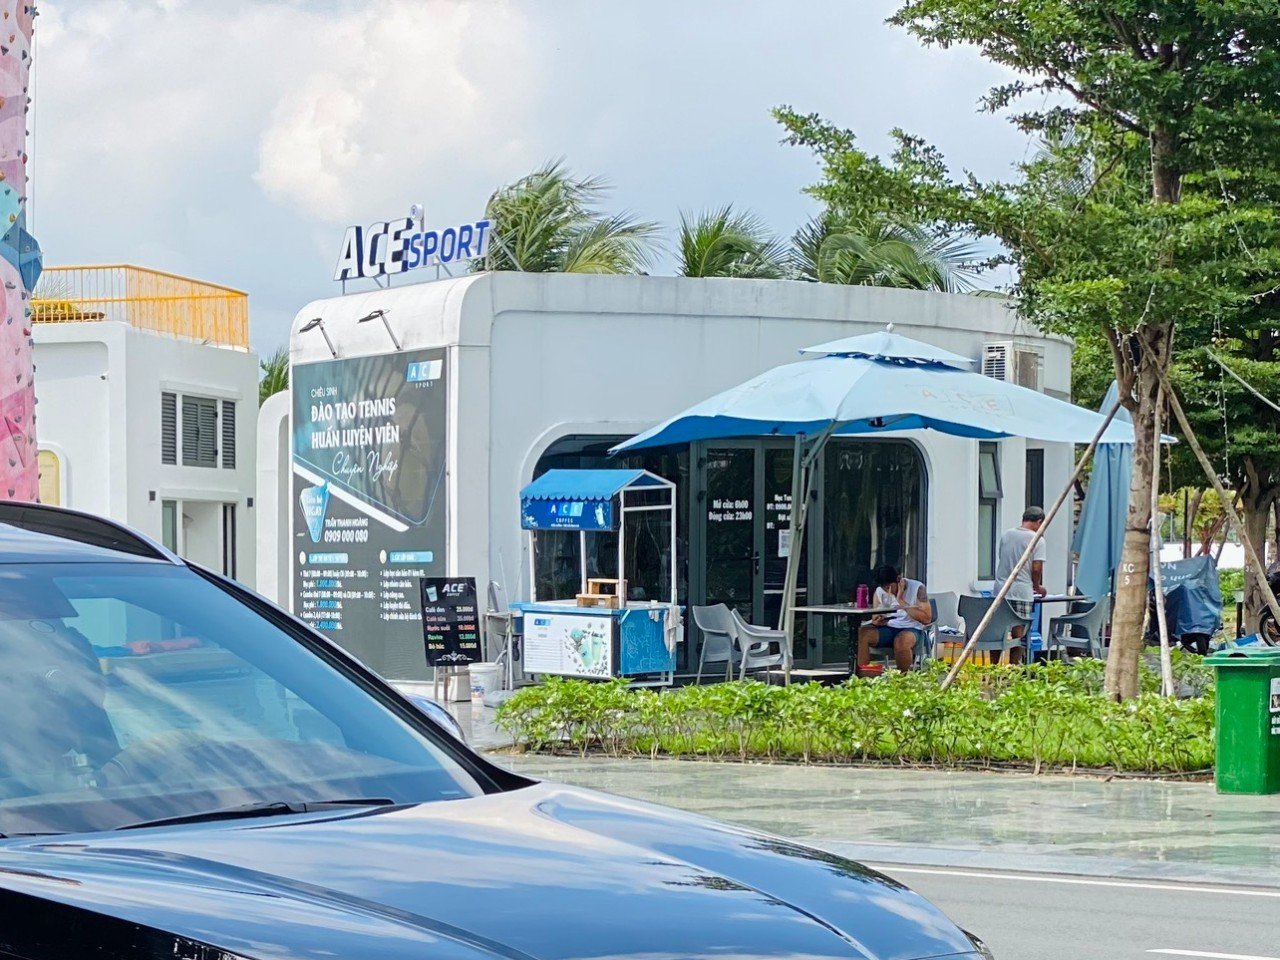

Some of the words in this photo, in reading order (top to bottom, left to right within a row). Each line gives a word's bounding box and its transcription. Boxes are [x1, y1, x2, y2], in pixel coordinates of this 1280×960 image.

[333, 217, 413, 281] ACE
[408, 219, 490, 269] SPORT
[326, 386, 338, 397] SINH
[311, 401, 333, 422] ĐÀO
[335, 401, 356, 423] TẠO
[359, 398, 396, 420] TENNIS
[311, 425, 340, 449] HUẤN
[342, 425, 373, 449] LUYỆN
[375, 422, 400, 443] VIÊN
[332, 451, 365, 485] Chuyên
[550, 504, 580, 515] ACE
[324, 530, 341, 543] 0909
[341, 530, 355, 543] 000
[442, 583, 465, 593] ACE
